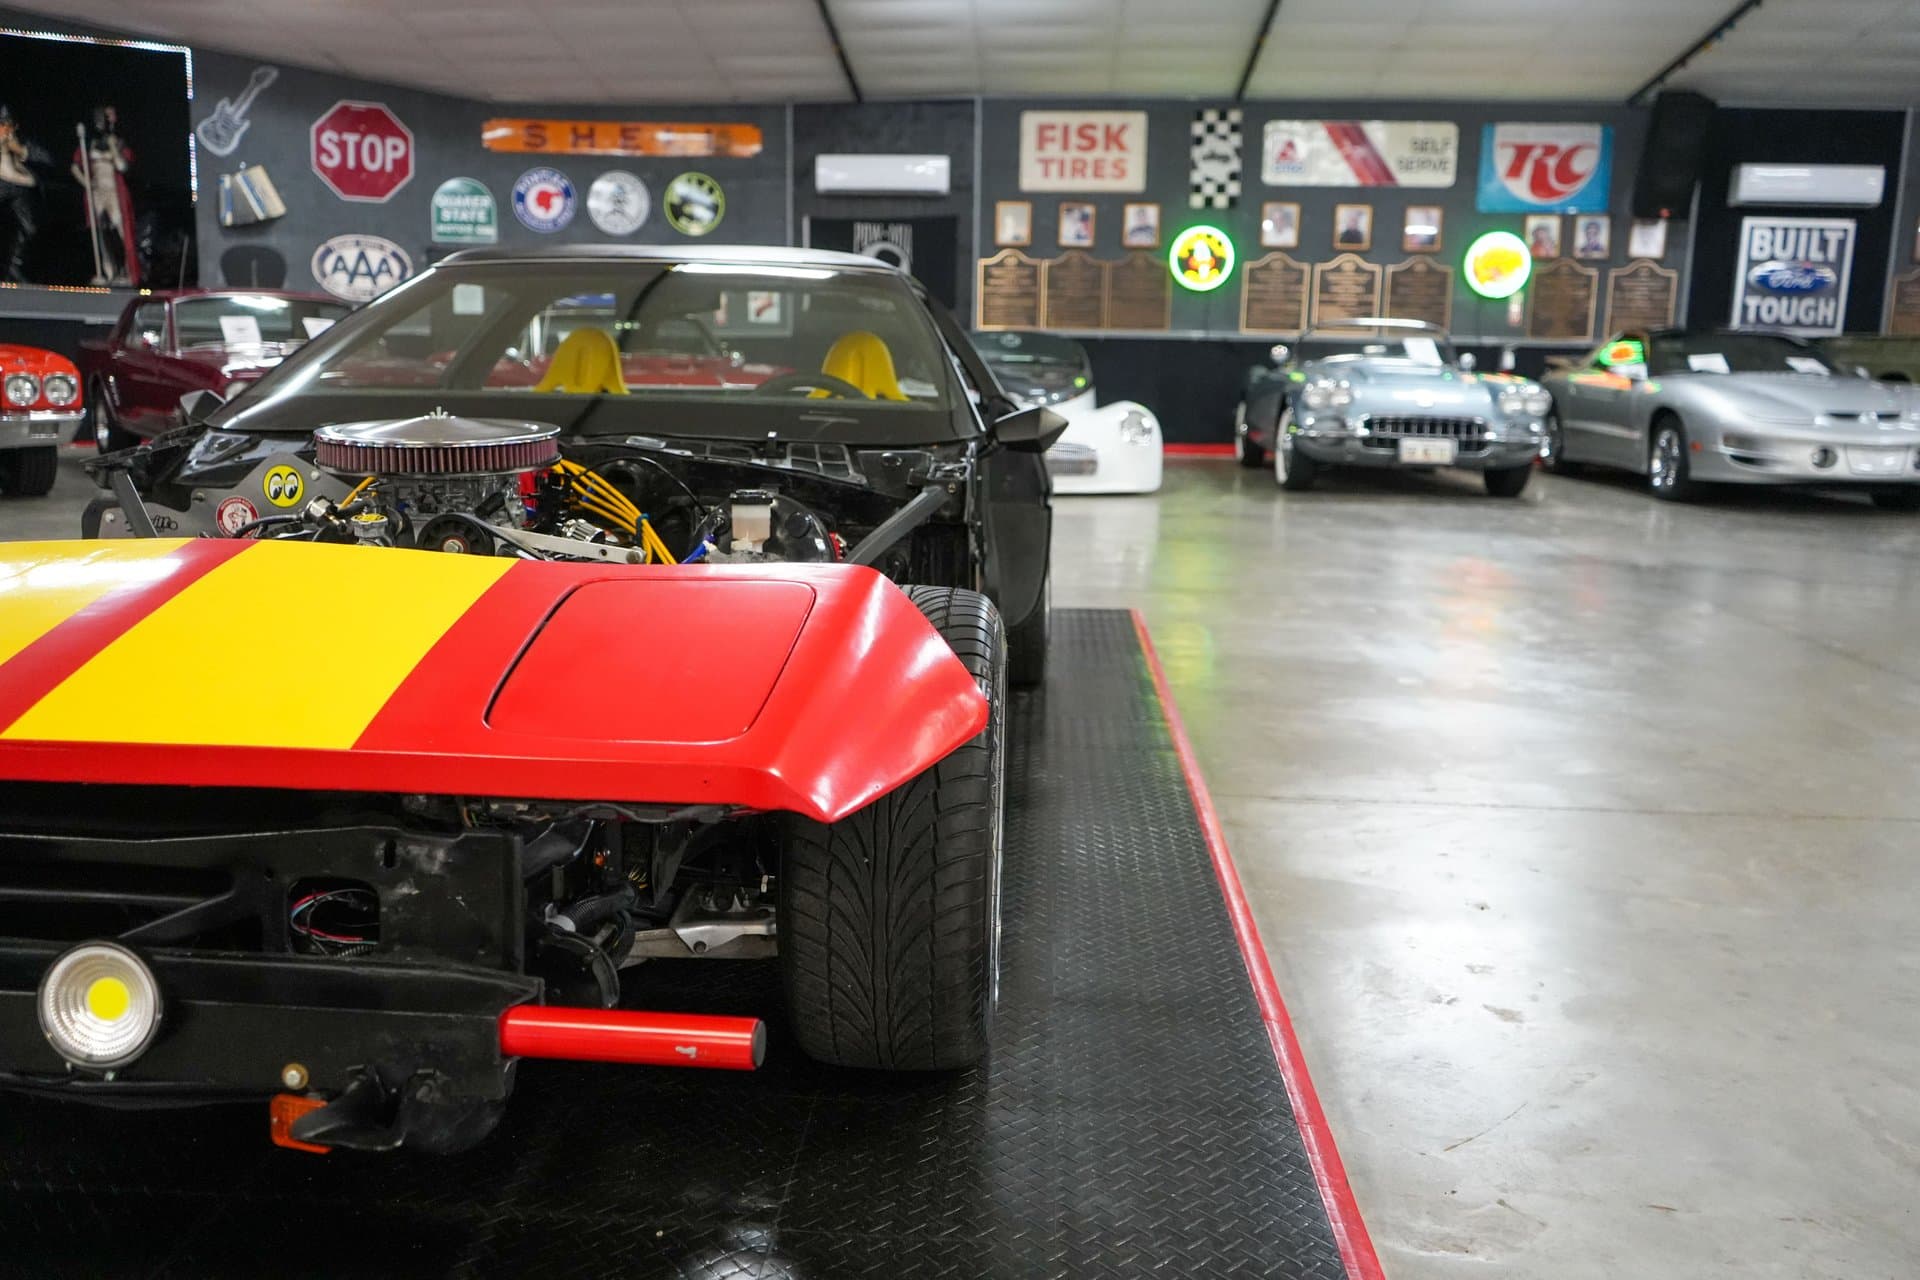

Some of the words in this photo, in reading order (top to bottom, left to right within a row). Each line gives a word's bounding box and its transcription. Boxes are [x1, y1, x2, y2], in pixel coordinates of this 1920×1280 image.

[319, 129, 407, 173] STOP
[522, 123, 729, 152] SHE
[1035, 123, 1129, 153] FISK
[1411, 138, 1451, 151] SELF
[1035, 158, 1129, 181] TIRES
[1398, 159, 1450, 170] SERVE
[1499, 143, 1597, 199] RC
[440, 207, 488, 222] STATE
[1750, 227, 1845, 262] BUILT
[331, 249, 394, 287] AAA
[1768, 268, 1817, 289] Ford
[1744, 296, 1837, 326] TOUGH
